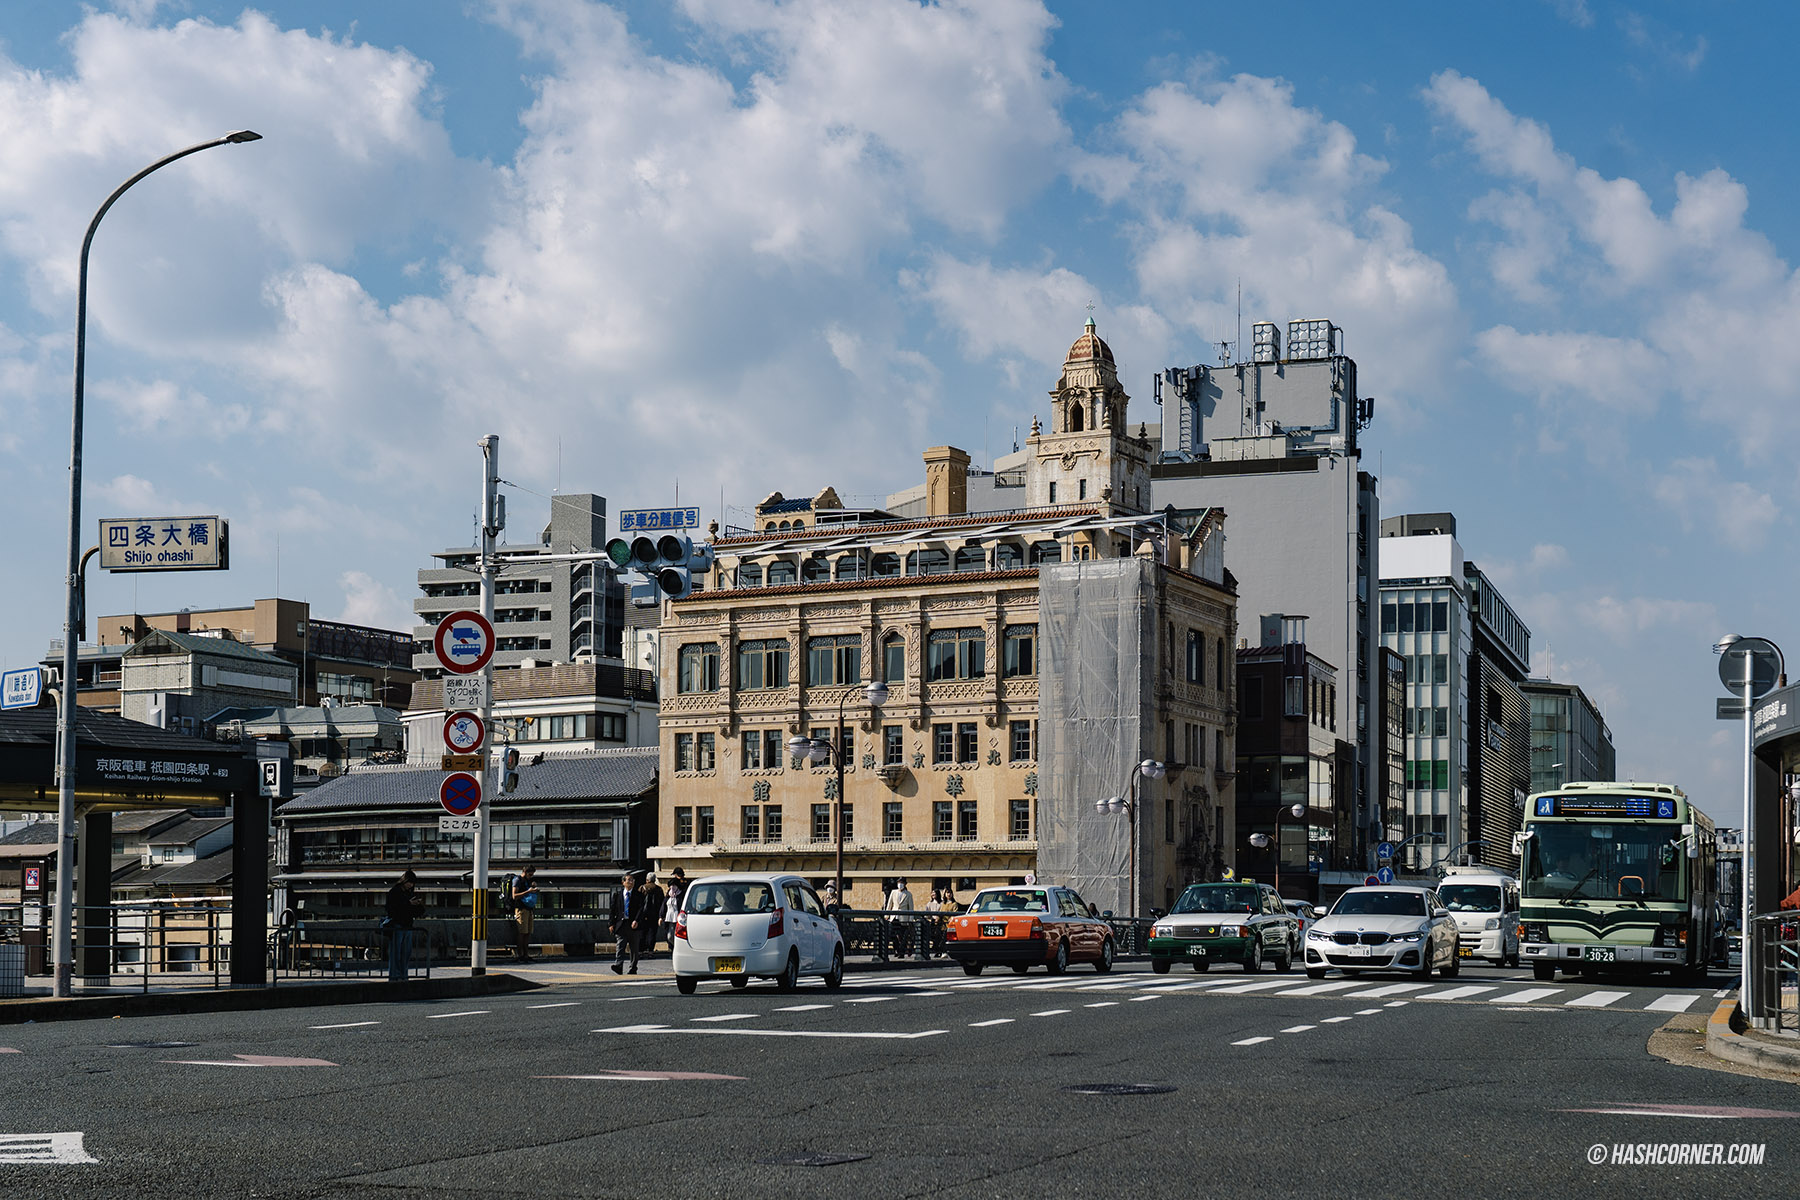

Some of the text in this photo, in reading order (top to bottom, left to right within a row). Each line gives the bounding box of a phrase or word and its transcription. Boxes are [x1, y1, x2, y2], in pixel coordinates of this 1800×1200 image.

[623, 510, 697, 529] 歩車分離信号
[109, 523, 209, 547] 四条大橋
[124, 549, 194, 564] Shijo ohashi
[96, 759, 147, 773] 京阪電車
[127, 774, 150, 782] Railway
[441, 820, 480, 829] ここから
[1590, 952, 1614, 961] 30-28
[720, 963, 740, 971] 97-60
